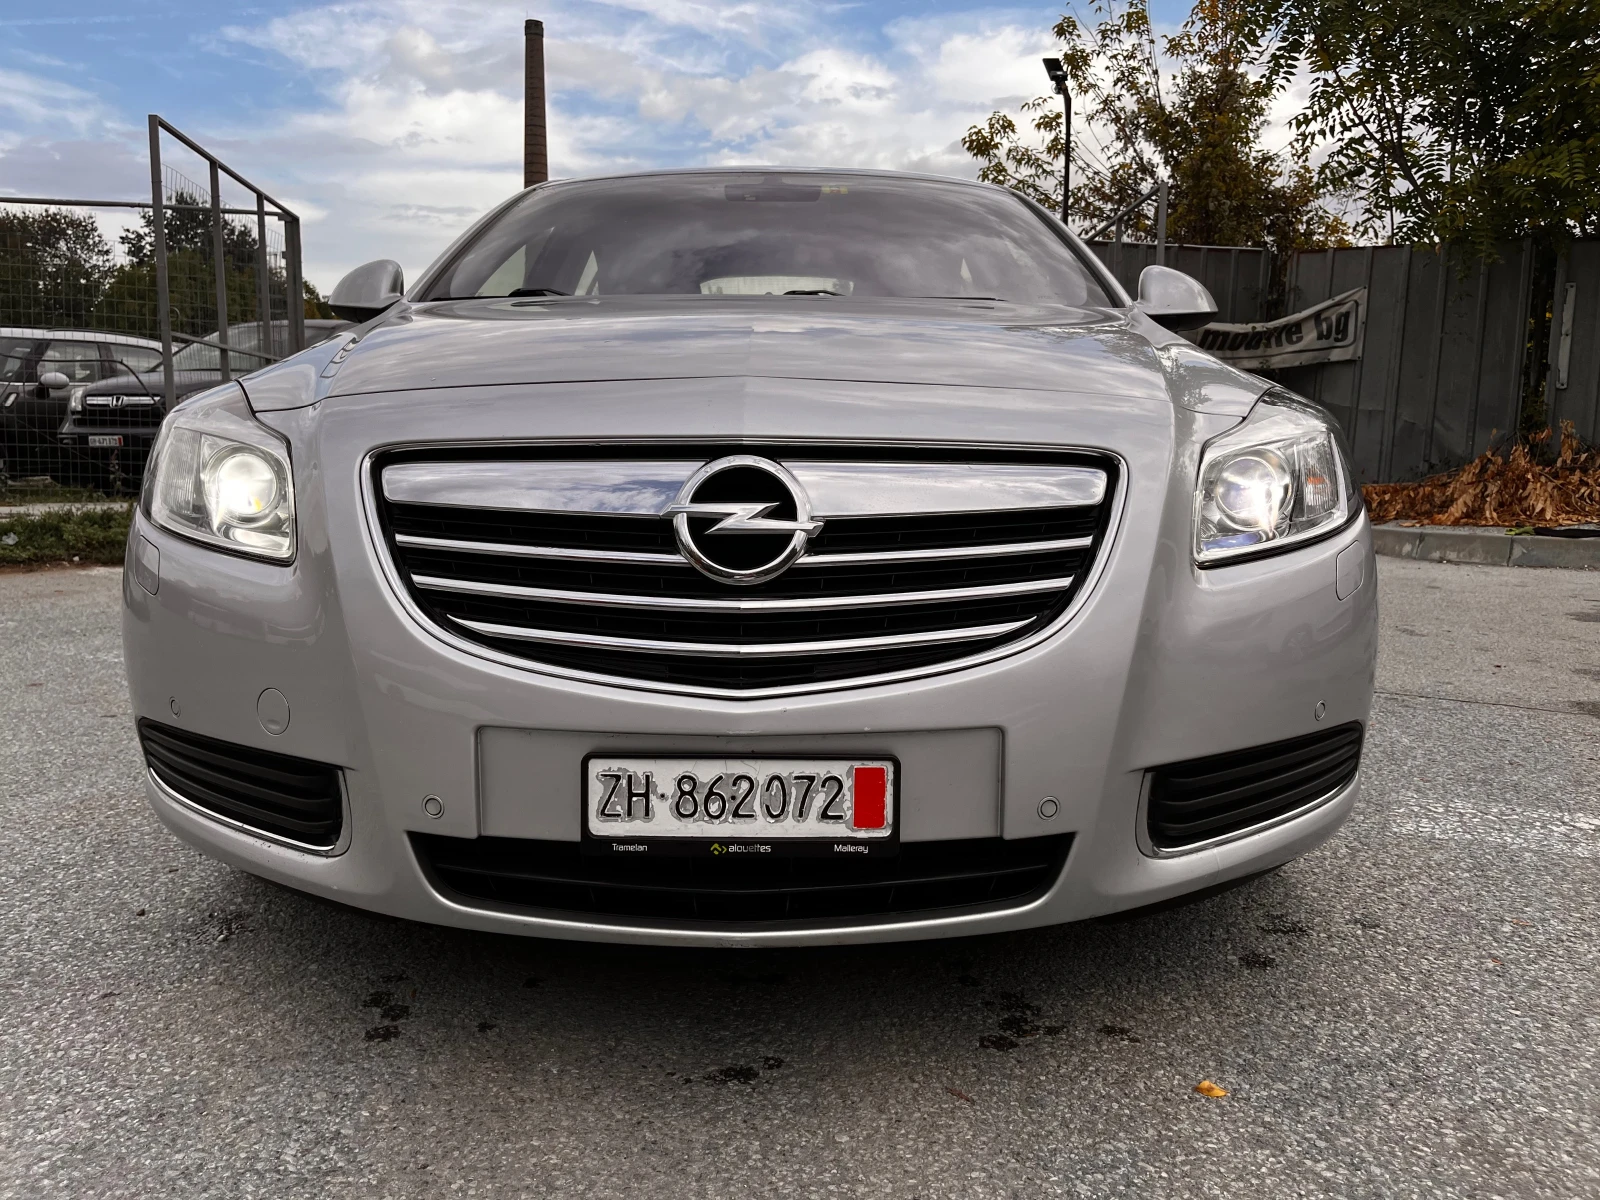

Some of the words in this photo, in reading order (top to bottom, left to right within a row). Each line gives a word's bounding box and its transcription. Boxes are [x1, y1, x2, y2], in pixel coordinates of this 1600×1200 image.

[1314, 310, 1350, 343] bg
[612, 843, 648, 852] Tramelan
[728, 844, 772, 853] alouettes
[834, 844, 869, 854] Malleray
